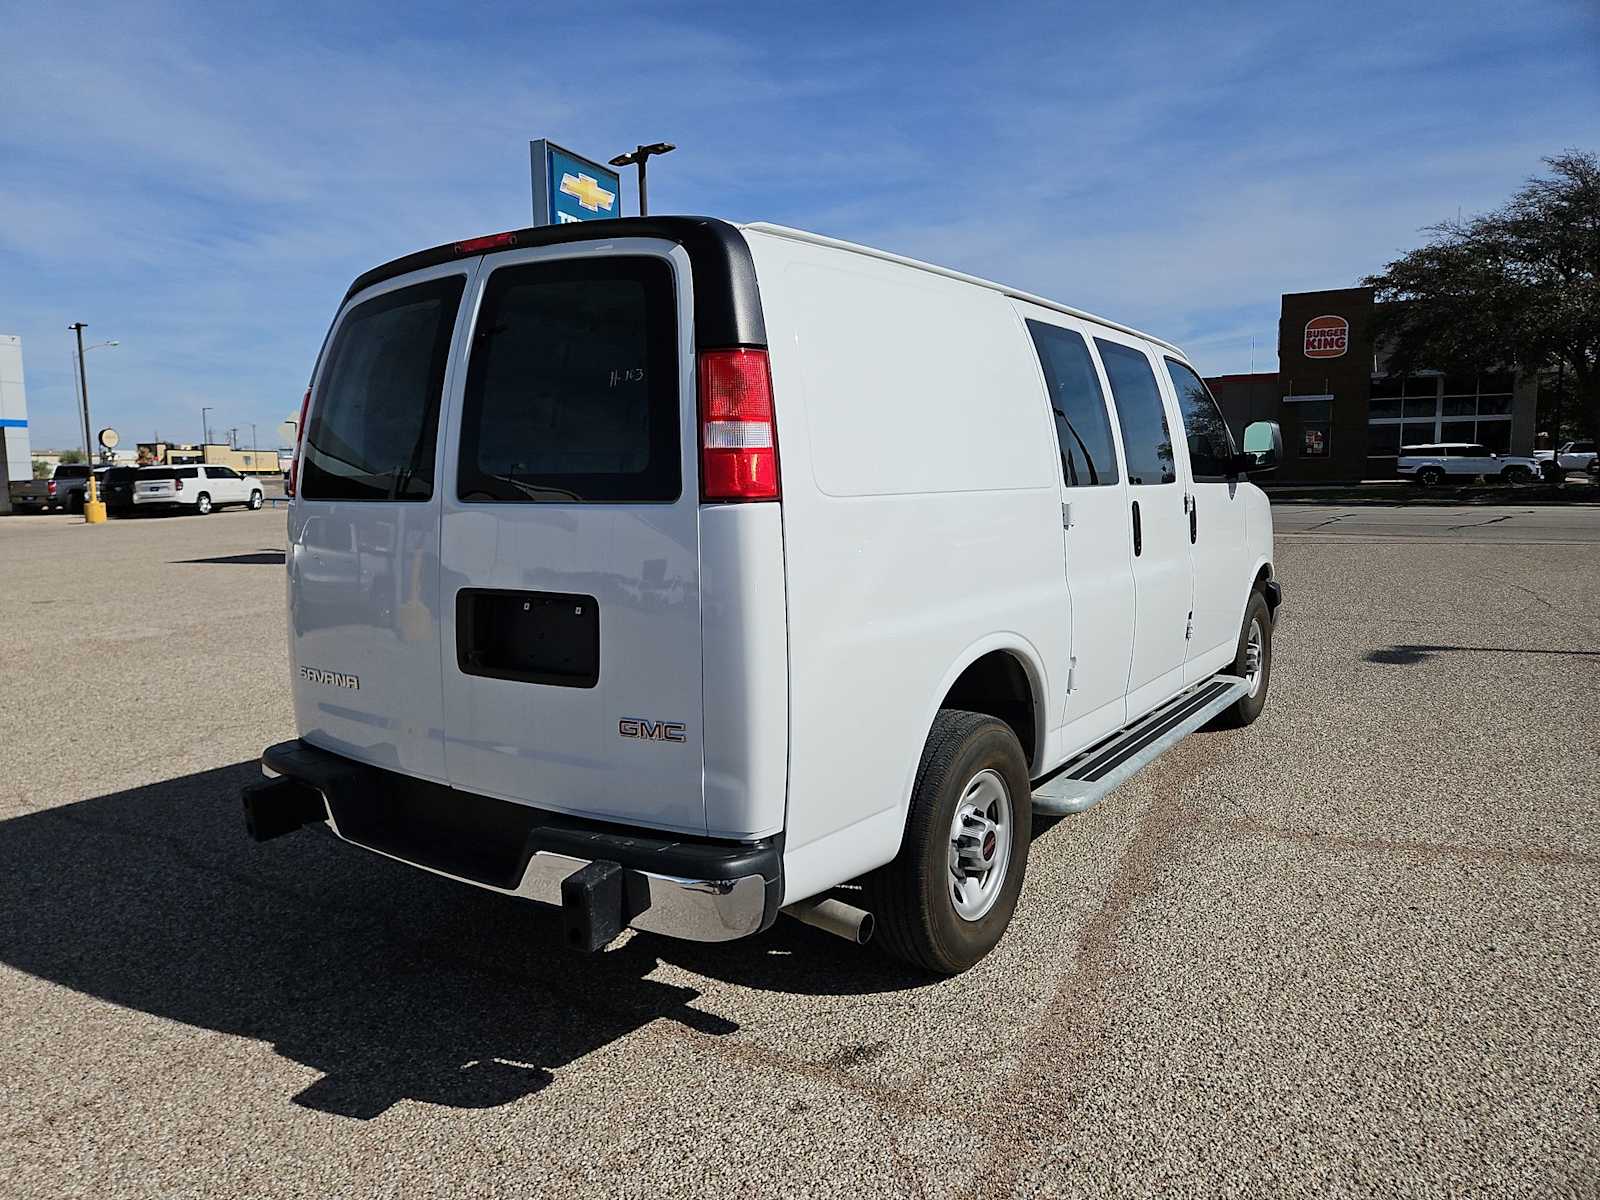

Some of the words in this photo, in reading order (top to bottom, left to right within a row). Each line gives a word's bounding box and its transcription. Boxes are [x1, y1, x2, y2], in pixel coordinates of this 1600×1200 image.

[1306, 328, 1346, 338] BURGER
[1305, 337, 1346, 350] KING
[300, 666, 360, 689] SAVANA
[618, 718, 687, 743] GMC
